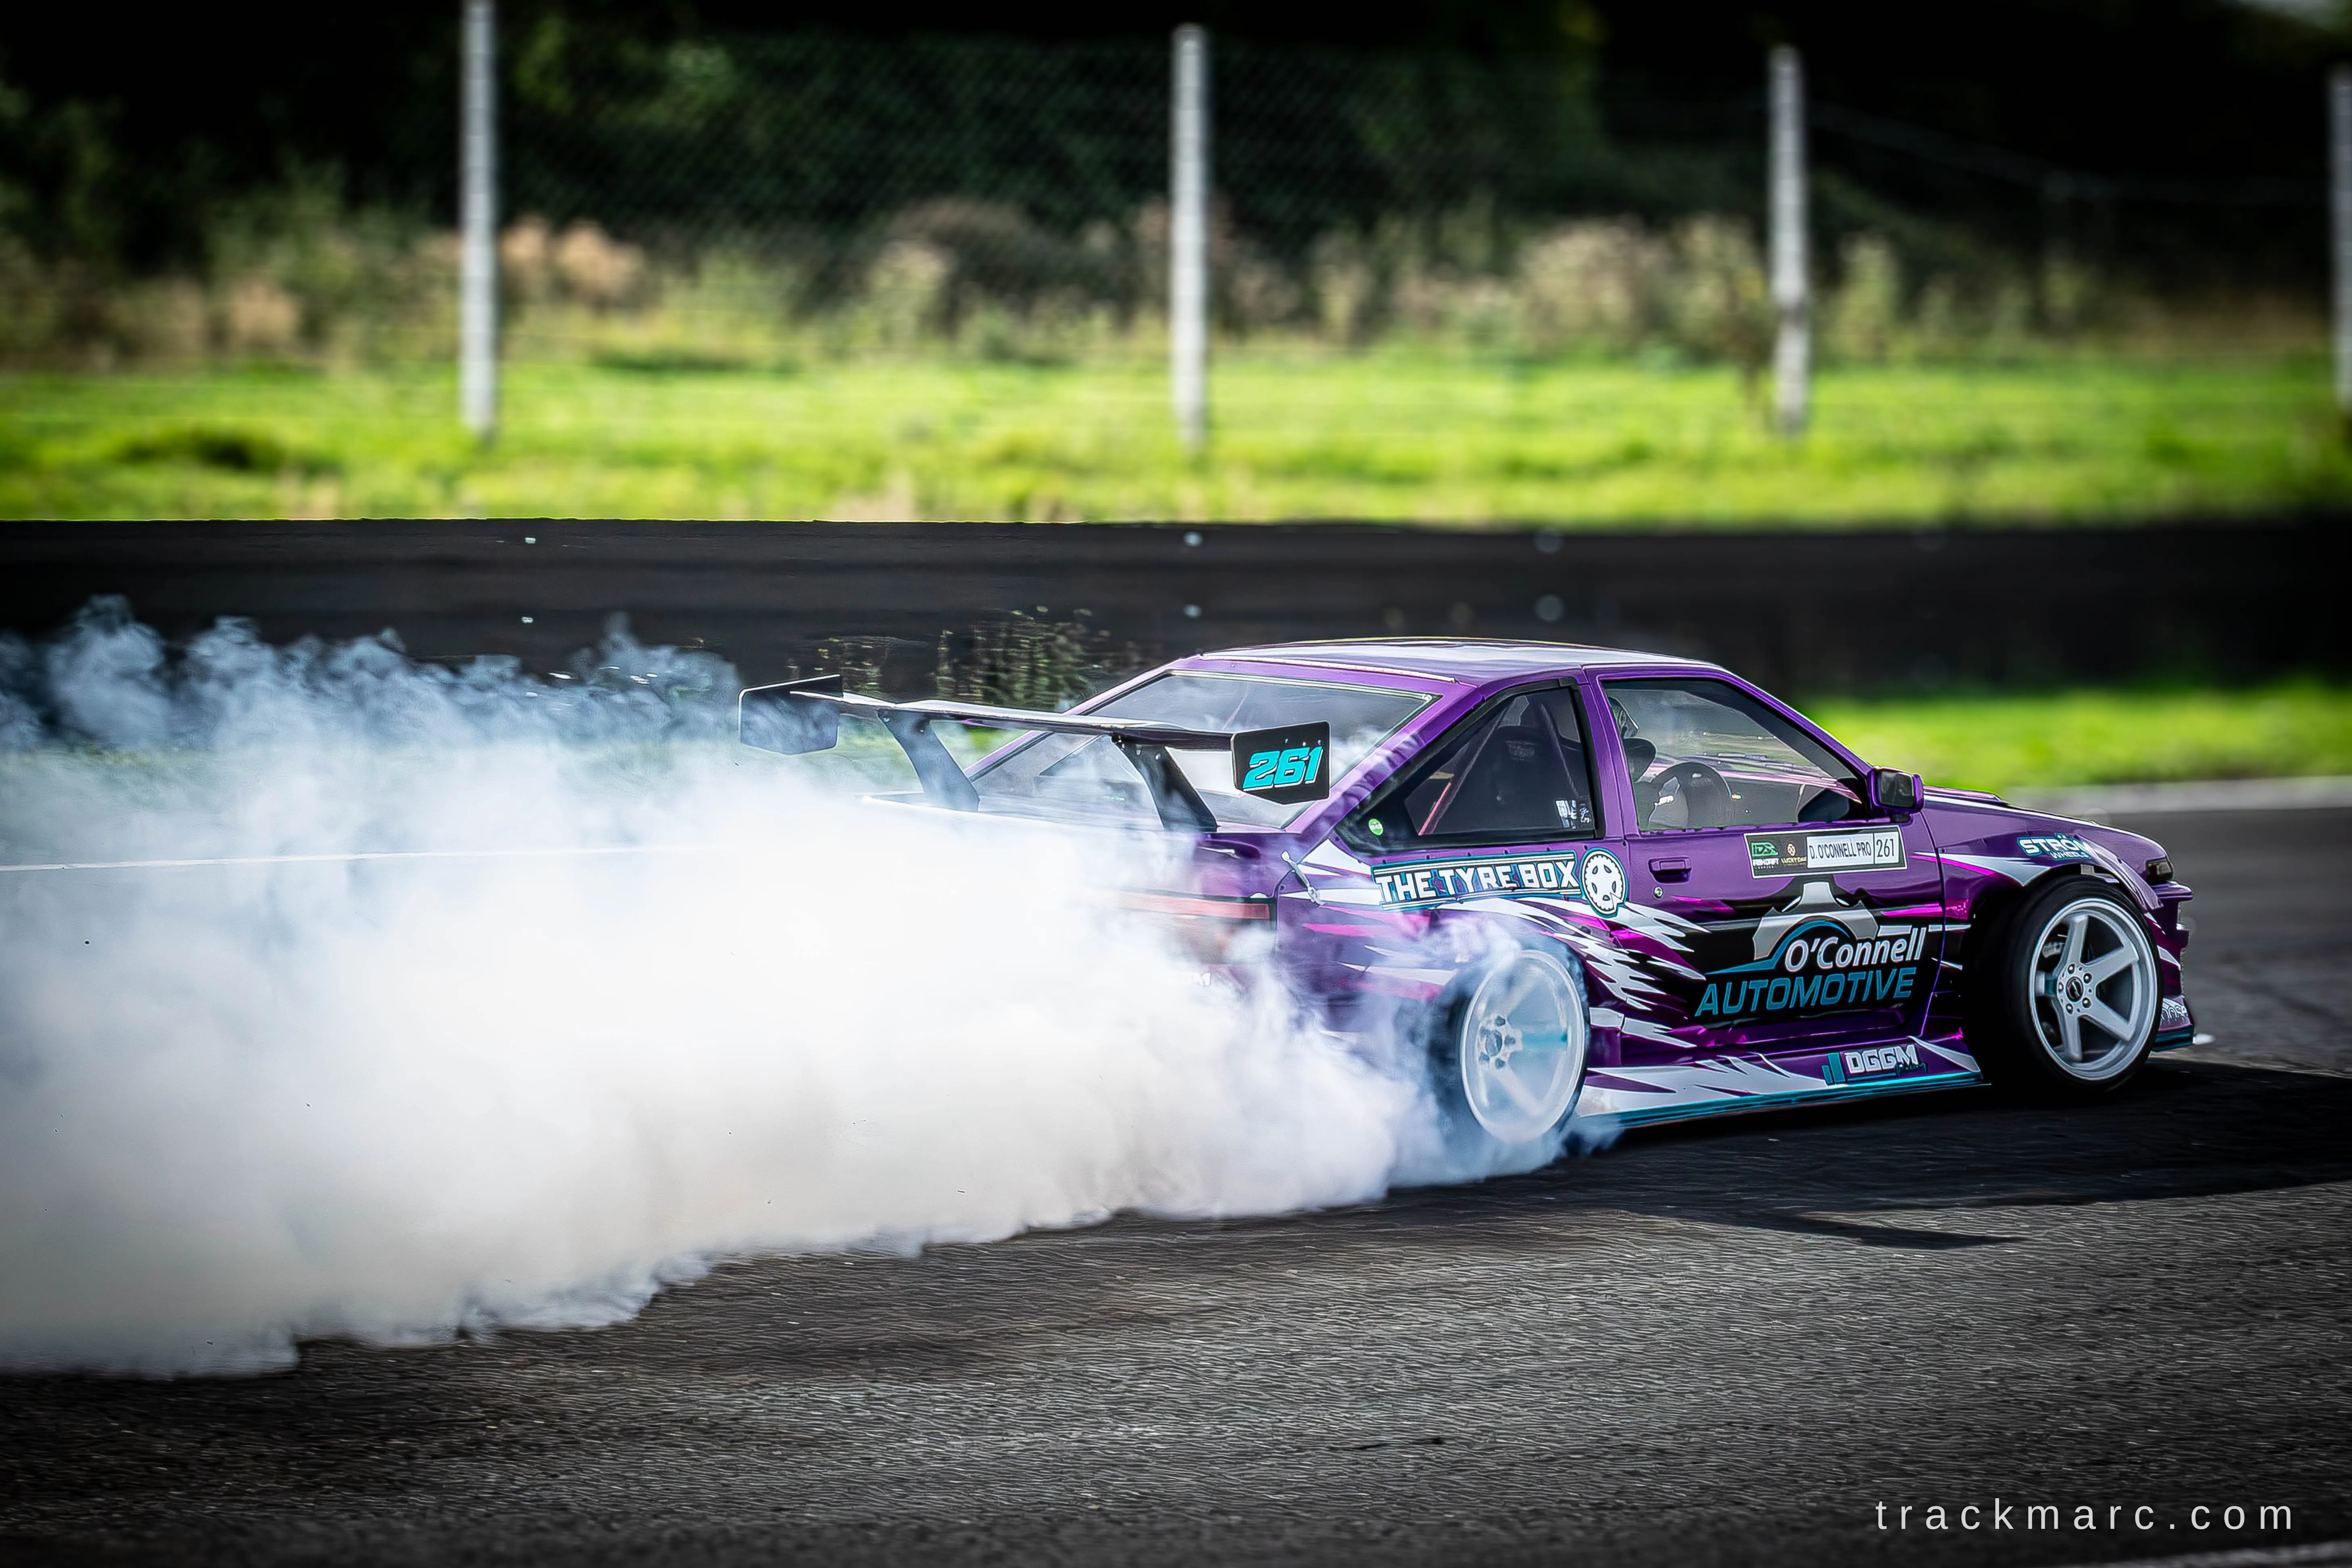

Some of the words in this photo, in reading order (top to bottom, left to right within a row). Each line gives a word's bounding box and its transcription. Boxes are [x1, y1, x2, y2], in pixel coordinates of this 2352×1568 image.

[1242, 746, 1323, 791] 261
[1809, 845, 1818, 859] D.
[1818, 842, 1856, 859] O'CONNELL
[1856, 841, 1872, 857] PRO
[1877, 838, 1895, 857] 261
[1375, 870, 1437, 903] THE
[1441, 863, 1516, 896] TYRE
[1519, 861, 1581, 888] BOX
[1785, 927, 1927, 972] O'Connell
[1695, 967, 1916, 1016] AUTOMOTIVE
[1844, 1044, 1919, 1074] DGGM
